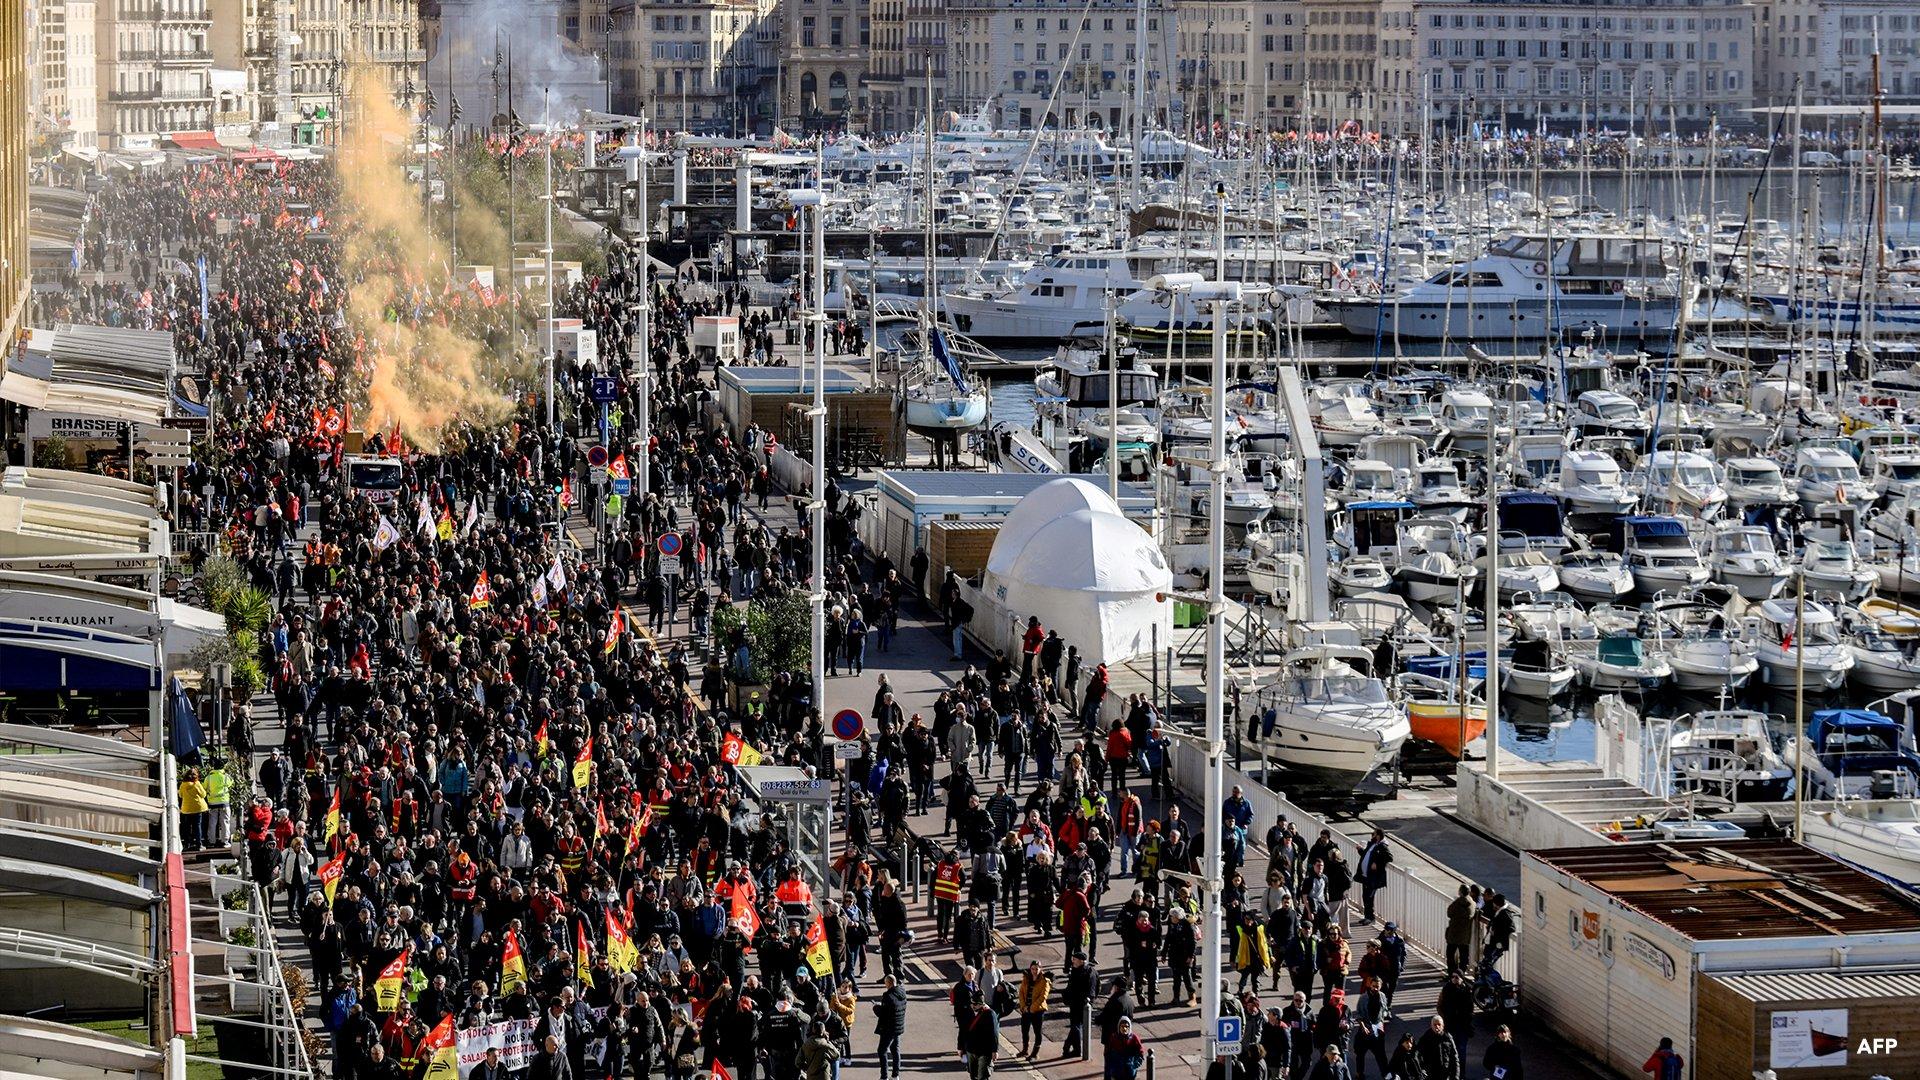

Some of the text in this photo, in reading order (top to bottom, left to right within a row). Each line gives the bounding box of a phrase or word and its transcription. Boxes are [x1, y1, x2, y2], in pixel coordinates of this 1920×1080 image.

[606, 381, 615, 395] P
[51, 418, 139, 432] BRASSERE
[1017, 447, 1050, 473] SCM
[366, 490, 385, 501] cgt
[0, 562, 13, 570] US
[115, 559, 148, 568] TAJINE
[458, 1025, 498, 1041] SYNDICAT
[501, 1022, 518, 1033] CGT
[1223, 1022, 1234, 1038] P
[505, 1032, 526, 1044] NOUS
[462, 1043, 537, 1064] SALAIR PROTECTIO
